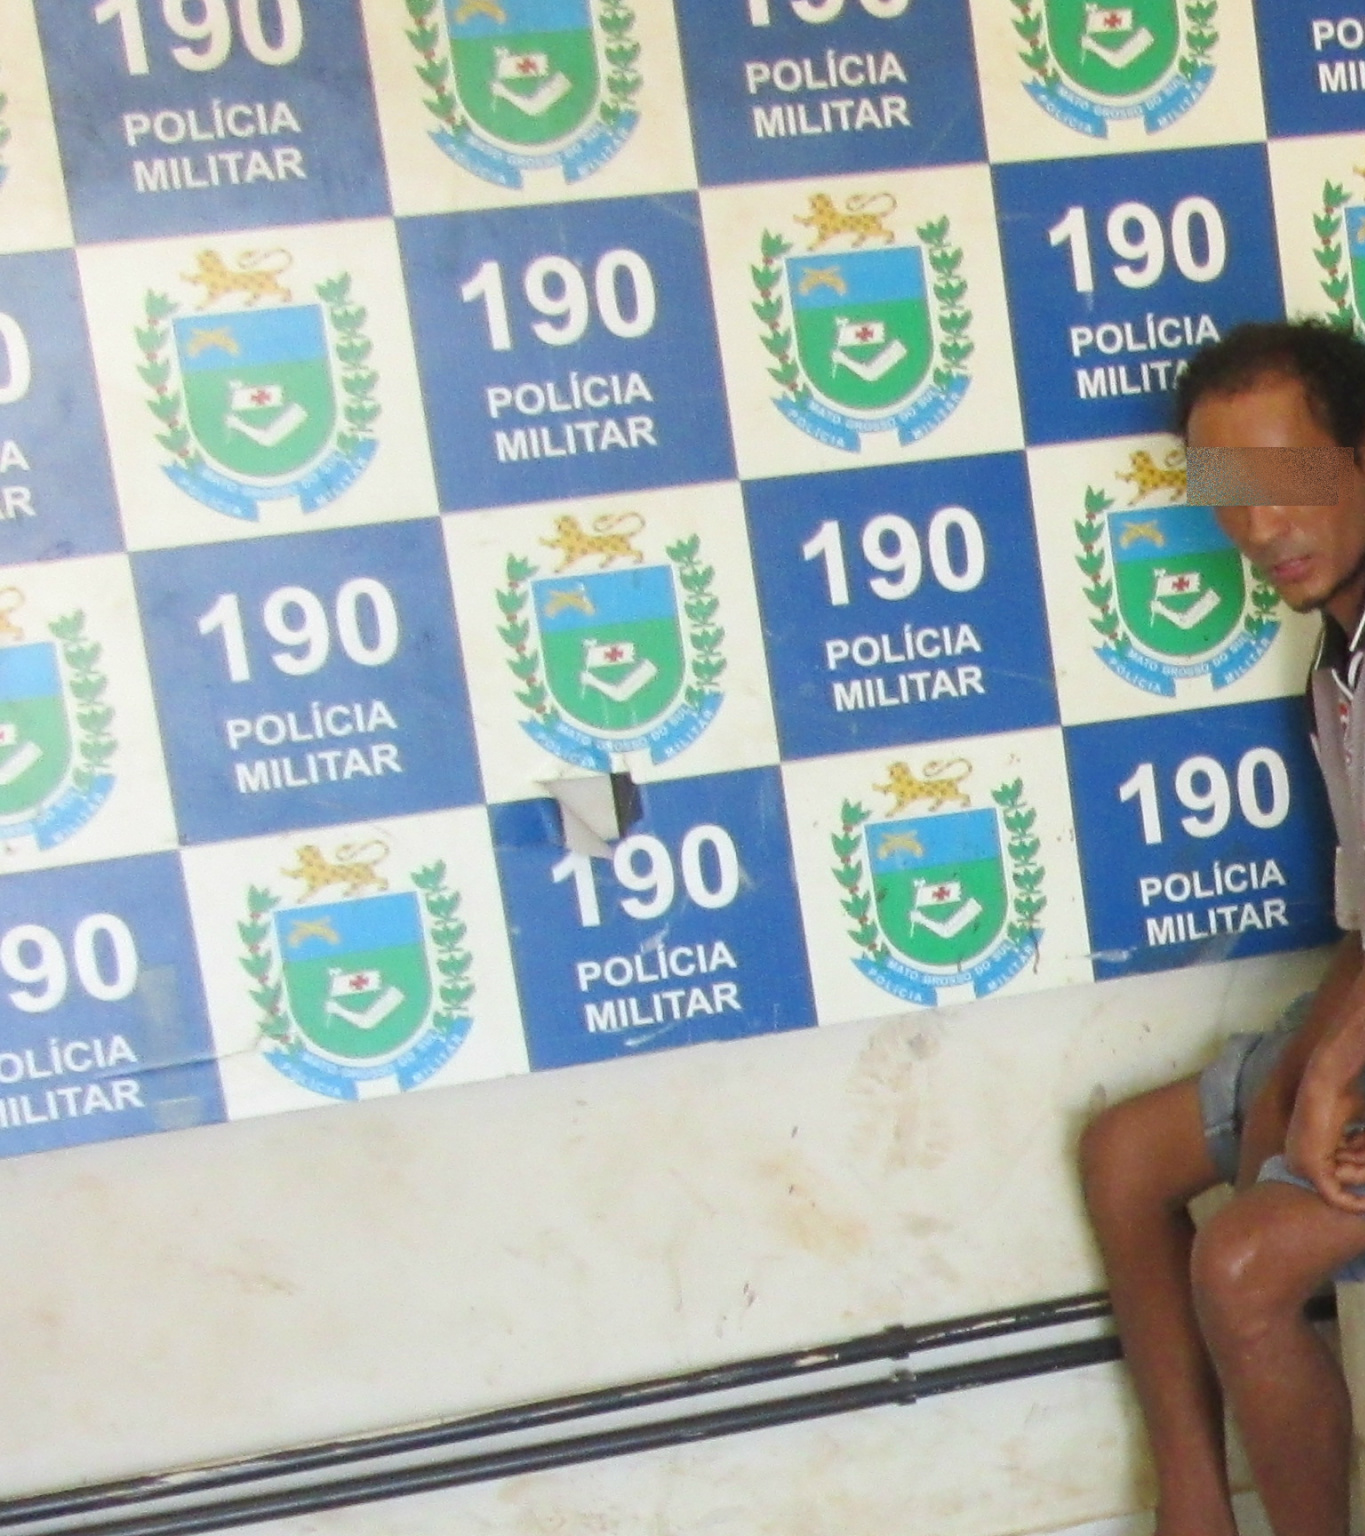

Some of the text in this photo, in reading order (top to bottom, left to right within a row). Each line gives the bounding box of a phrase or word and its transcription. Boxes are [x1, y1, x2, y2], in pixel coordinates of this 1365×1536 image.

[94, 0, 302, 75] 190
[745, 48, 906, 94] POLÍCIA
[123, 99, 301, 146] POLÍCIA
[753, 95, 909, 138] MILITAR
[133, 147, 305, 192] MILITAR
[1049, 196, 1225, 292] 190
[461, 249, 655, 350] 190
[1070, 313, 1220, 356] POLÍCIA
[486, 372, 652, 420] POLÍCIA
[494, 416, 656, 462] MILITAR
[803, 506, 985, 605] 190
[198, 578, 398, 681] 190
[826, 624, 981, 672] POLÍCIA
[833, 665, 984, 711] MILITAR
[225, 701, 397, 748] POLÍCIA
[235, 744, 401, 793] MILITAR
[1120, 747, 1289, 844] 190
[552, 825, 740, 926] 190
[1140, 860, 1285, 906] POLÍCIA
[1147, 899, 1287, 946] MILITAR
[0, 913, 137, 1012] 90
[578, 941, 737, 991] POLÍCIA
[988, 945, 1032, 991] MILITAR
[585, 982, 741, 1032] MILITAR
[0, 1035, 138, 1083] OLÍCIA
